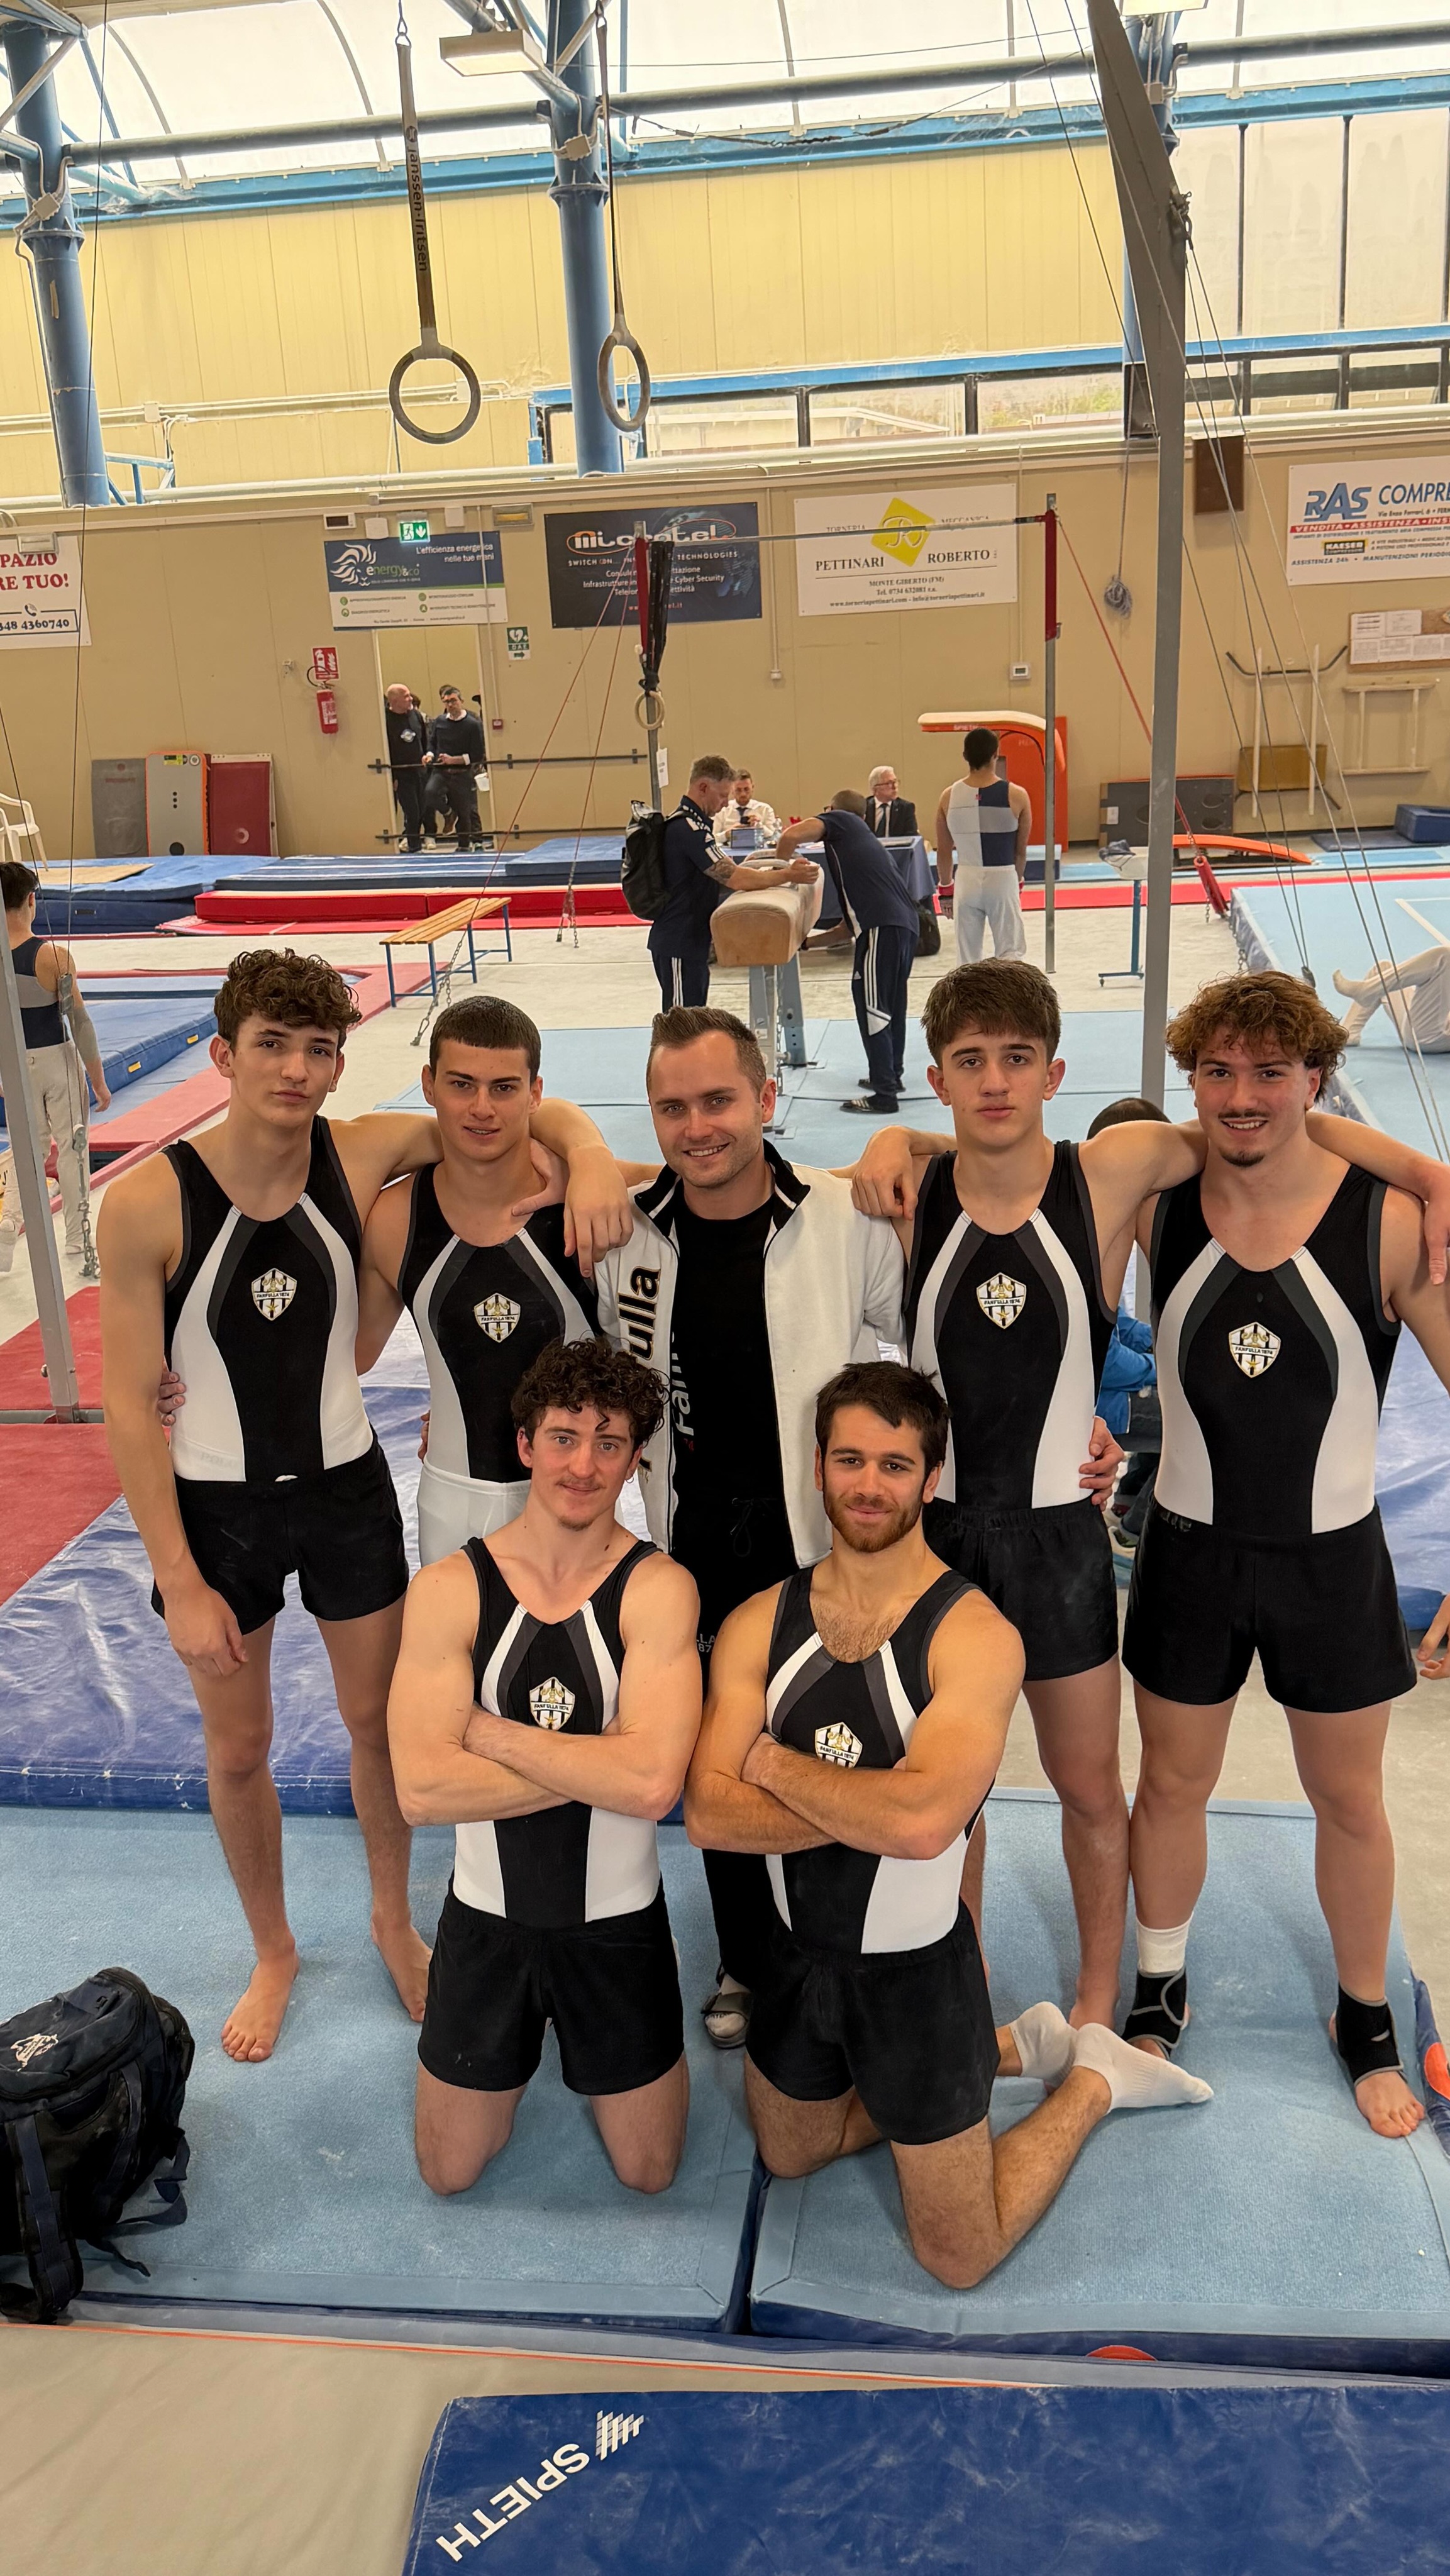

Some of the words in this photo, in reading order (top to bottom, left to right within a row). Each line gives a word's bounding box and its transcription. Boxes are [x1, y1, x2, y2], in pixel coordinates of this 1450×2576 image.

[1303, 482, 1372, 522] RAS
[1295, 523, 1343, 532] VENDITA
[1428, 517, 1450, 526] INS
[815, 556, 885, 571] PETTINARI
[927, 549, 990, 564] ROBERTO
[22, 573, 69, 589] TUO!
[21, 619, 70, 630] 4360740
[436, 2443, 590, 2562] SPIETH
